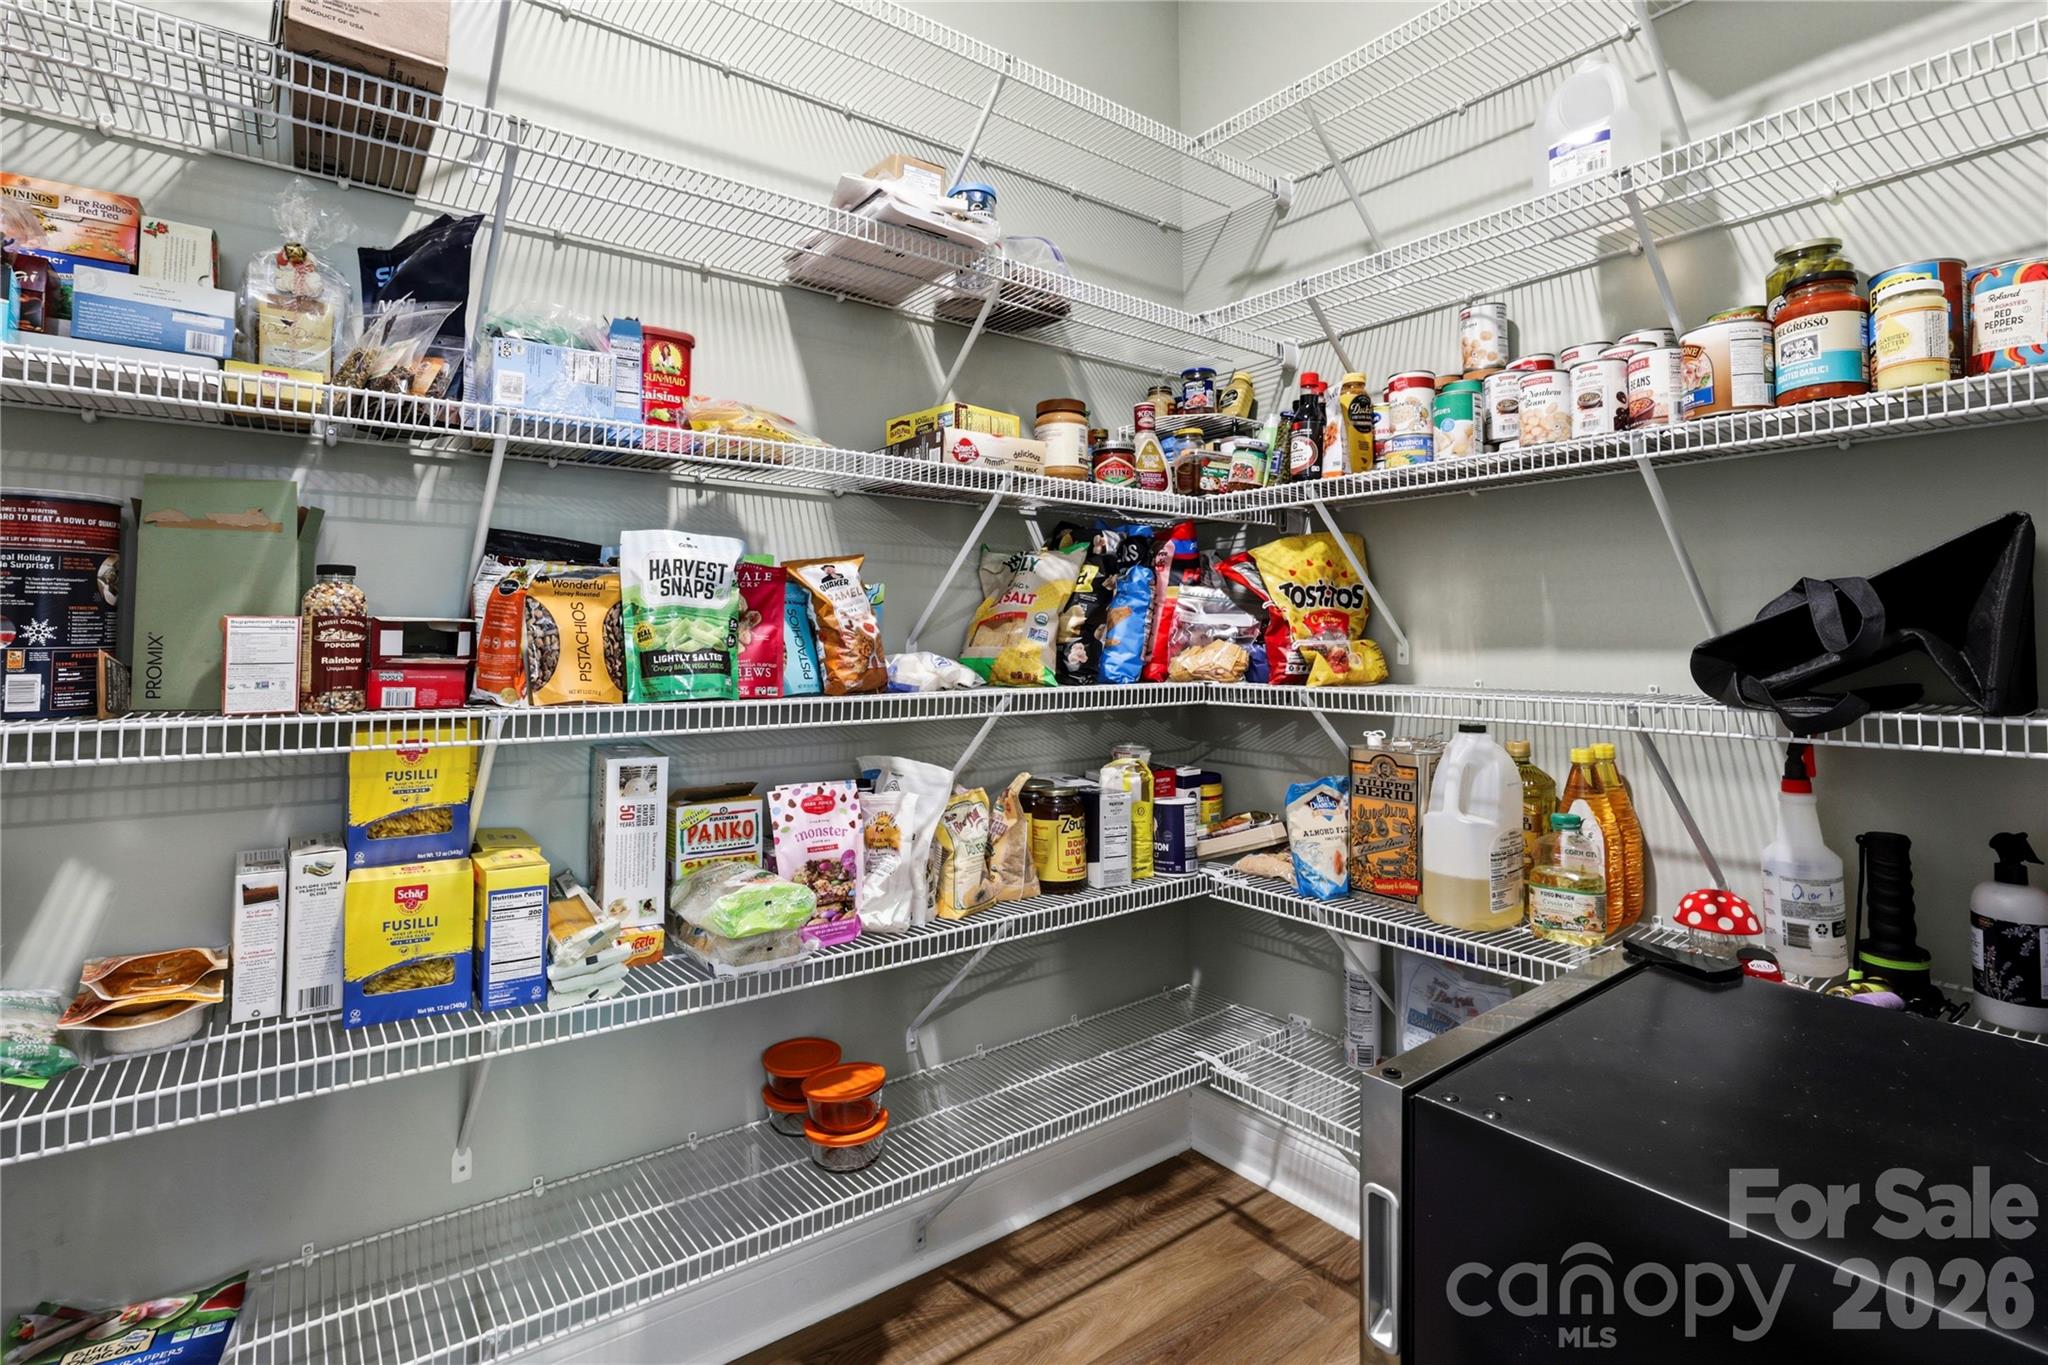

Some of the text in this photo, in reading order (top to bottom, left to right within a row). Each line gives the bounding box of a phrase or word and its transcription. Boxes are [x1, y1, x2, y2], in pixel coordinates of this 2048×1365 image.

[300, 5, 336, 21] PRODUCT
[349, 21, 365, 31] USA
[0, 187, 54, 204] WININGS
[64, 195, 133, 216] Pure Rooibos
[78, 205, 119, 220] Red Tea
[1988, 289, 2021, 303] Roland
[1994, 308, 2012, 319] RED
[1984, 315, 2024, 331] PEPPERS
[1013, 449, 1041, 462] delicious
[31, 514, 54, 522] BEAT
[64, 517, 86, 526] BOWL
[17, 554, 51, 562] Holiday
[10, 561, 55, 570] Surprises
[649, 558, 729, 584] HARVEST
[736, 571, 772, 581] ALE
[552, 579, 606, 592] Wonderful
[660, 577, 715, 600] SNAPS
[819, 578, 849, 592] QUAKER
[554, 590, 600, 598] Honey Roasted
[1003, 592, 1037, 604] SALT
[318, 618, 338, 627] AMISH
[570, 601, 593, 682] PISTACHIOS
[786, 608, 813, 680] PISTACHIOS
[321, 656, 362, 665] Rainbow
[653, 652, 723, 664] LIGHTLY SALTED
[146, 634, 164, 699] PROMIX
[385, 768, 438, 782] FUSILLI
[1359, 777, 1411, 791] FILIPPO
[1354, 784, 1413, 802] BERIO
[619, 805, 635, 820] 50
[687, 820, 754, 845] PANKO
[795, 826, 848, 842] monster
[1303, 826, 1349, 837] ALMOND FLO
[1065, 848, 1081, 856] BRO
[397, 889, 426, 900] Schär
[529, 908, 542, 916] 200
[383, 915, 438, 932] FUSILLI
